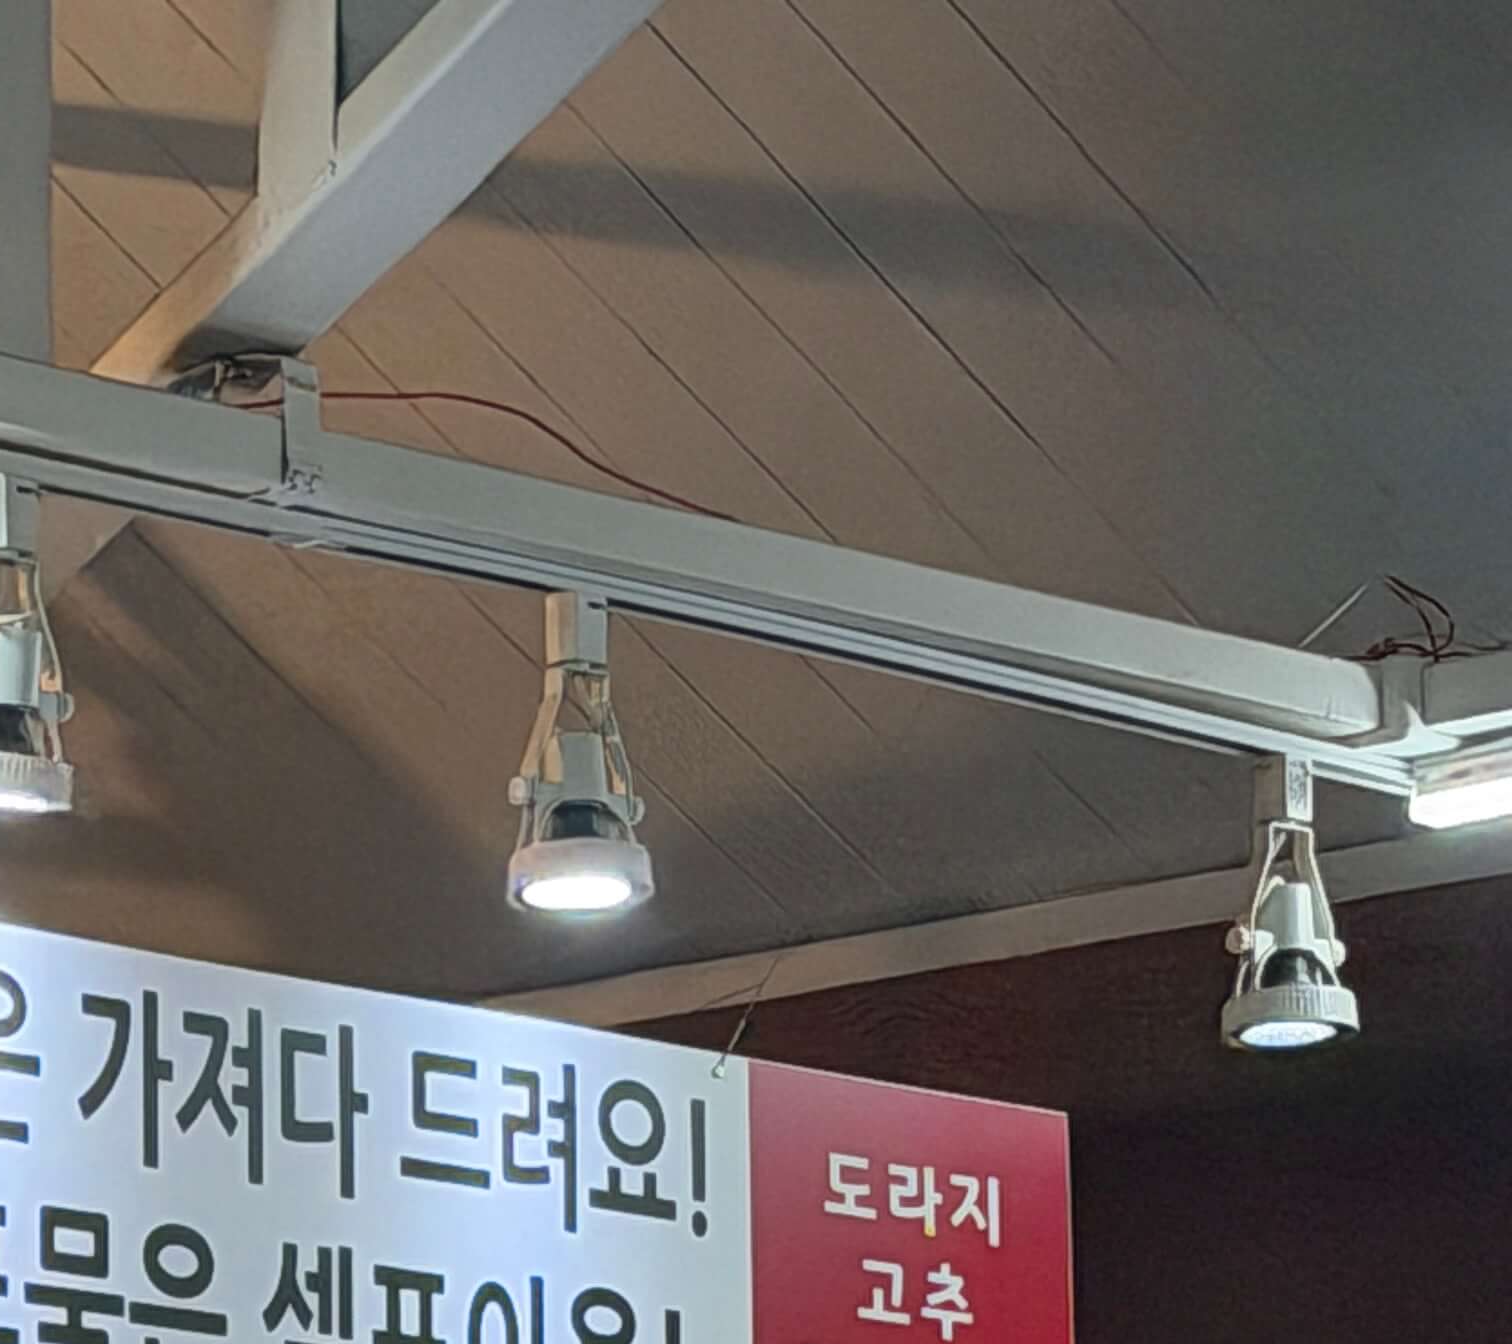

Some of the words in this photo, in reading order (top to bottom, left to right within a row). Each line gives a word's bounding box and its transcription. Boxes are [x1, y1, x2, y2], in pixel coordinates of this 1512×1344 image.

[78, 990, 369, 1199] 가져다
[400, 1051, 708, 1237] 드려요!
[824, 1151, 1000, 1247] 도라지
[857, 1259, 973, 1341] 고추
